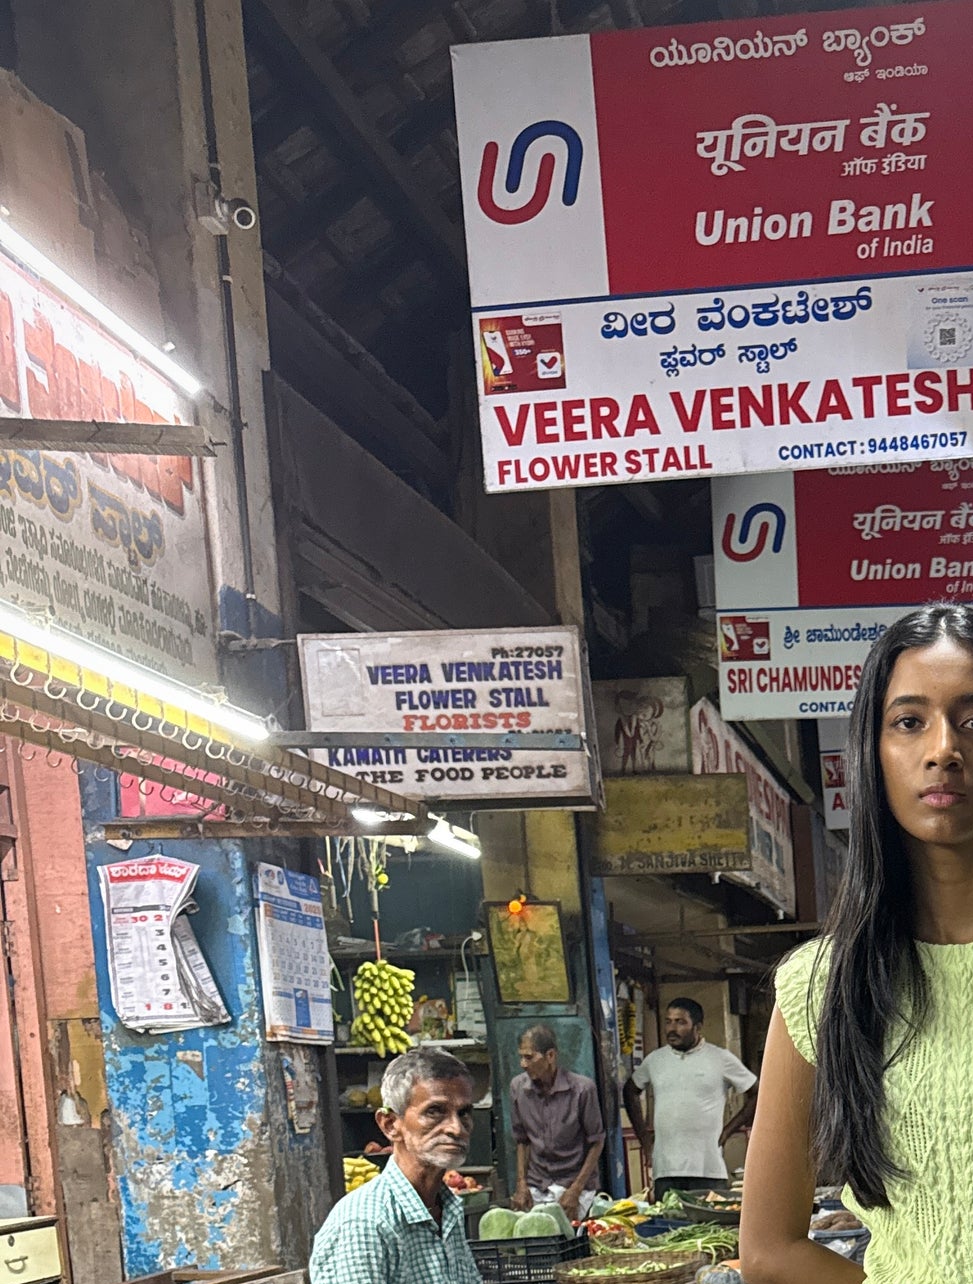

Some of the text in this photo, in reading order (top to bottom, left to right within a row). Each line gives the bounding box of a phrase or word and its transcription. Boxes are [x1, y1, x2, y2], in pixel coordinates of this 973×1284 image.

[649, 18, 926, 67] ಯೂನಿಯನ್ ಬ್ಯಾಂಕ್
[696, 102, 930, 175] यूनियन बैंक
[840, 152, 927, 177] ऑफ इंडिया
[694, 193, 933, 247] Union Bank
[856, 234, 934, 260] of India
[600, 286, 872, 339] ವೀರ ವೆಂಕಟೇಶ್
[737, 338, 798, 374] ಸ್ಟಾಲ್
[494, 392, 662, 447] VEERA
[497, 444, 713, 485] FLOWER STALL
[852, 504, 945, 540] यूनियन
[850, 559, 920, 581] Union
[946, 580, 959, 594] of
[366, 660, 563, 685] VEERA VENKATESH
[727, 668, 752, 693] SRI
[395, 687, 549, 710] FLOWER STALL
[403, 711, 531, 731] FLORISTS
[355, 764, 567, 784] THE FOOD PEOPLE
[160, 973, 170, 981] 6
[161, 988, 171, 996] 7
